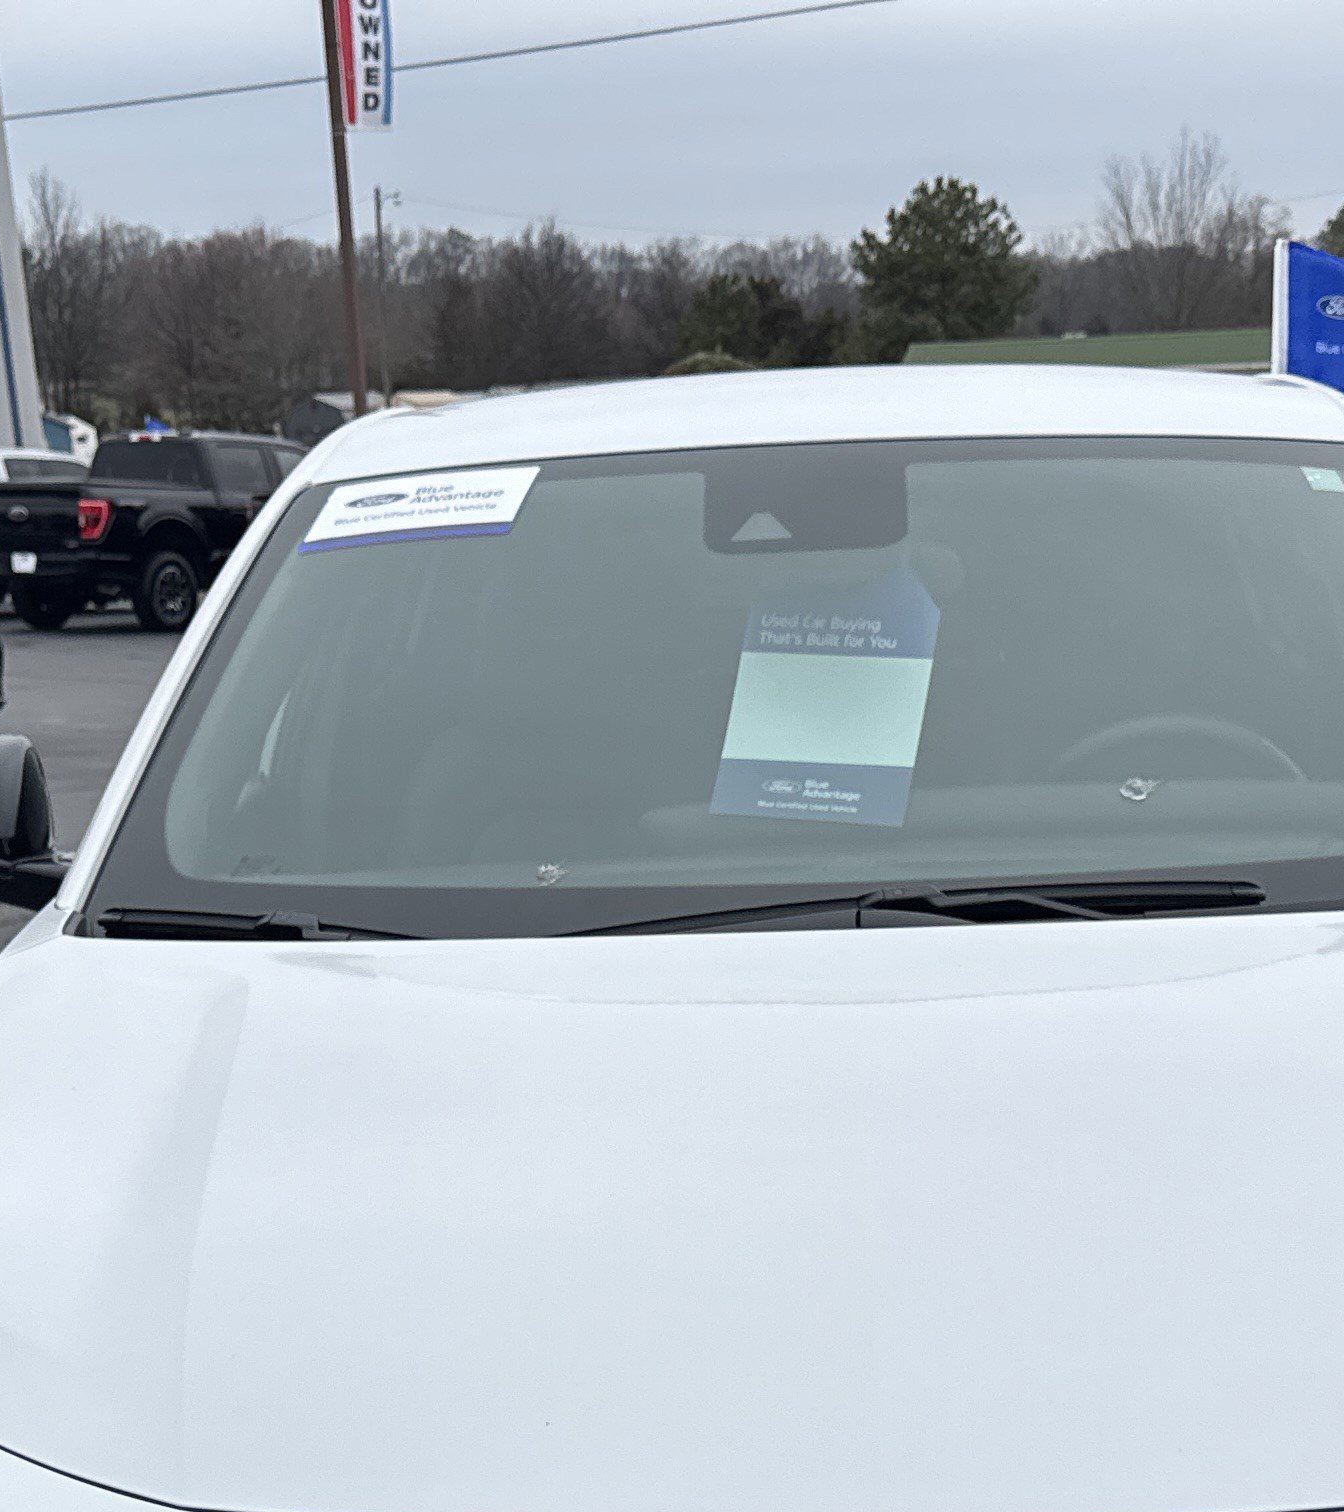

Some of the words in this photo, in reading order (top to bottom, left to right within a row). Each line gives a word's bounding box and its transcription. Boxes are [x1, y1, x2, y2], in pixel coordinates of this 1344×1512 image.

[414, 484, 455, 495] Blue
[409, 490, 505, 504] Advantage
[761, 613, 800, 628] Used
[830, 615, 882, 633] Buying
[760, 631, 803, 646] That's
[806, 632, 840, 647] Built
[843, 632, 865, 648] for
[869, 634, 898, 649] You
[804, 779, 830, 789] Blue
[802, 789, 861, 801] Advantage
